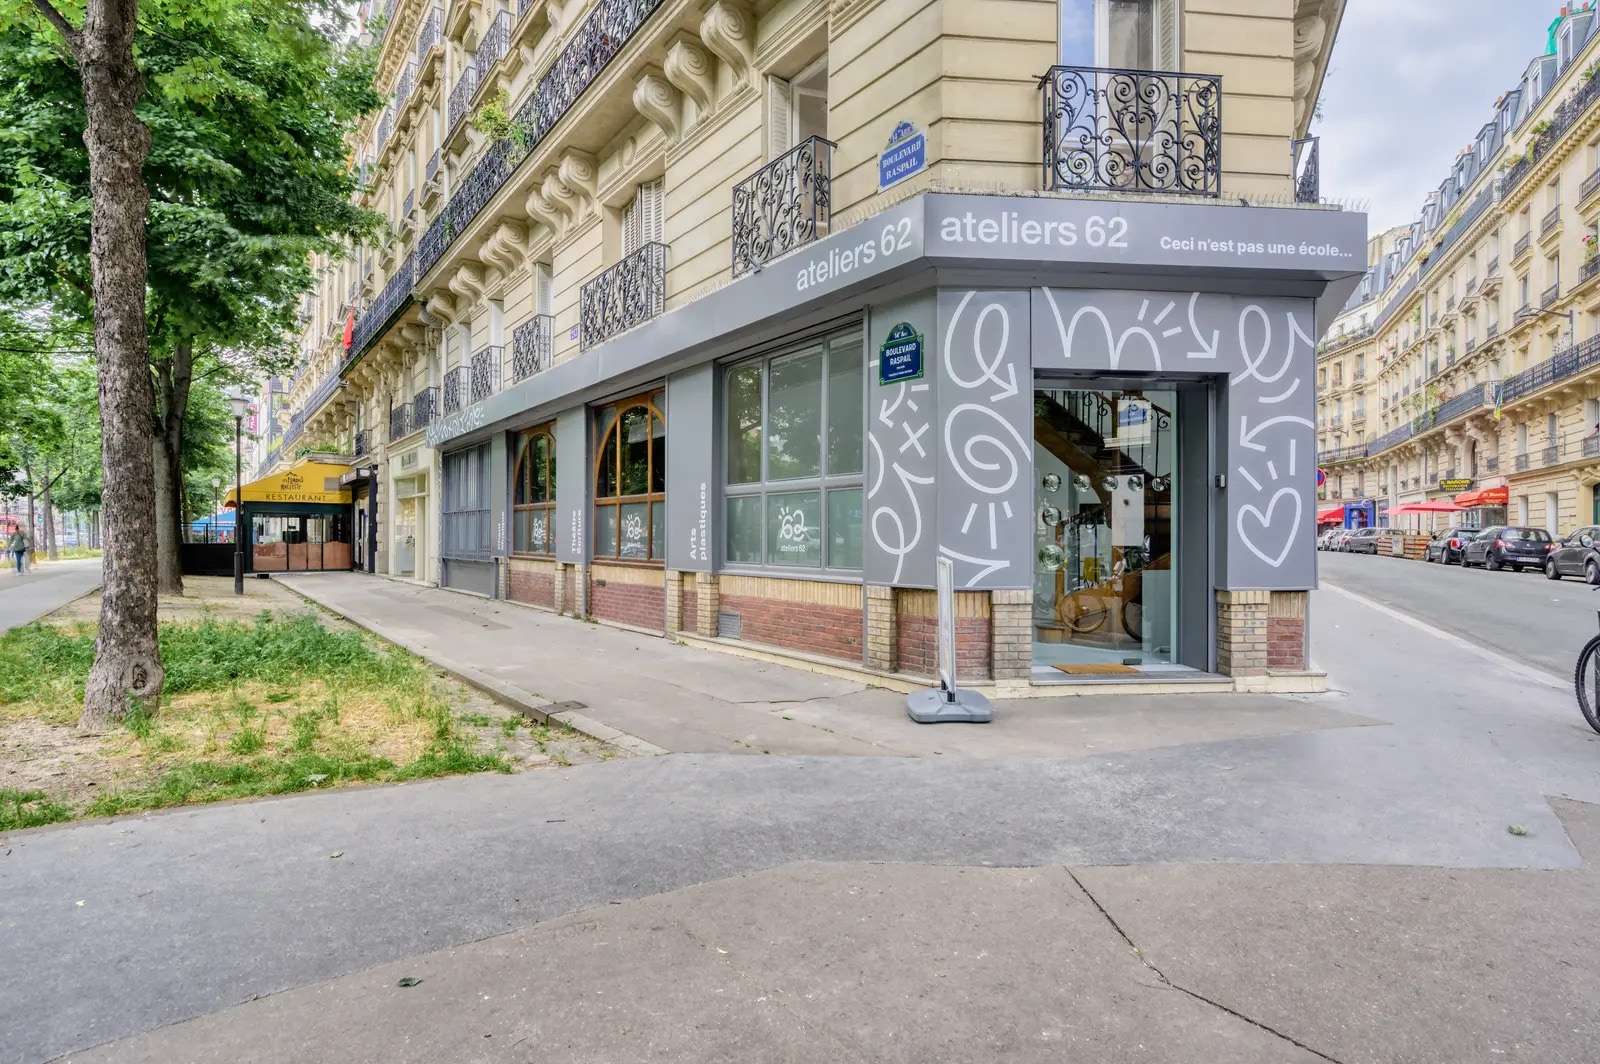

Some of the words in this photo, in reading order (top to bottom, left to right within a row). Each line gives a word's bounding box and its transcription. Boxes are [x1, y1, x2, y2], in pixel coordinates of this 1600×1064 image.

[882, 140, 922, 169] BOULEVARD
[885, 156, 918, 180] RASPAIL
[940, 211, 1078, 246] ateliers
[1085, 215, 1129, 248] 62
[796, 240, 876, 291] ateliers
[881, 217, 912, 256] 62
[1160, 236, 1195, 251] Ceci
[1198, 238, 1235, 252] n’est
[1237, 241, 1265, 256] pas
[1267, 243, 1296, 255] une
[1299, 241, 1353, 258] école...
[885, 343, 917, 357] BOULEVARD
[890, 354, 911, 366] RASPAIL
[266, 493, 326, 502] RESTAURANT
[699, 482, 708, 560] plastiques
[780, 509, 807, 541] 62
[781, 544, 798, 552] ateliers
[799, 544, 806, 552] 62
